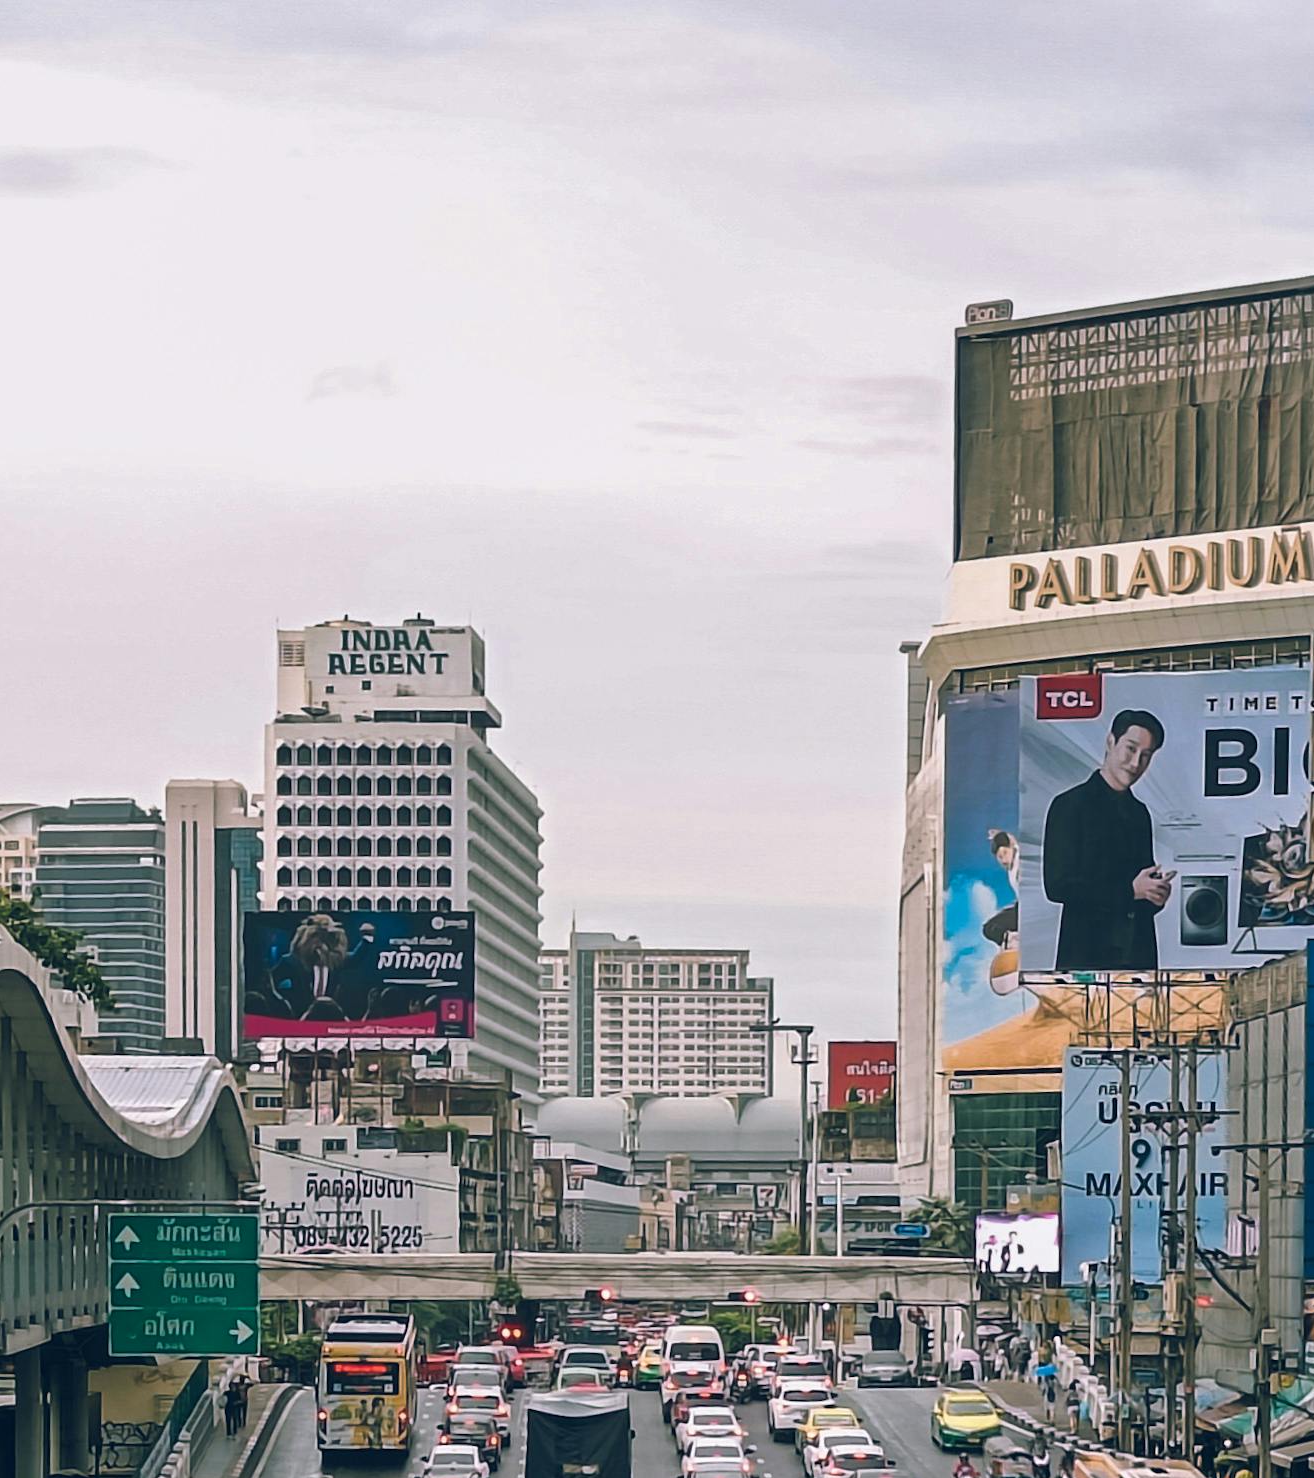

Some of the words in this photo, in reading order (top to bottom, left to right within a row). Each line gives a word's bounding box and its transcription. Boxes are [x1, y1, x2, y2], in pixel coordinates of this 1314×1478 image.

[328, 653, 450, 675] REGENT
[1045, 690, 1095, 709] TCL
[1206, 696, 1279, 712] TIME
[156, 1217, 241, 1243] มักกะสัน
[163, 1266, 236, 1289] ดินแดง
[144, 1311, 195, 1337] อโศก
